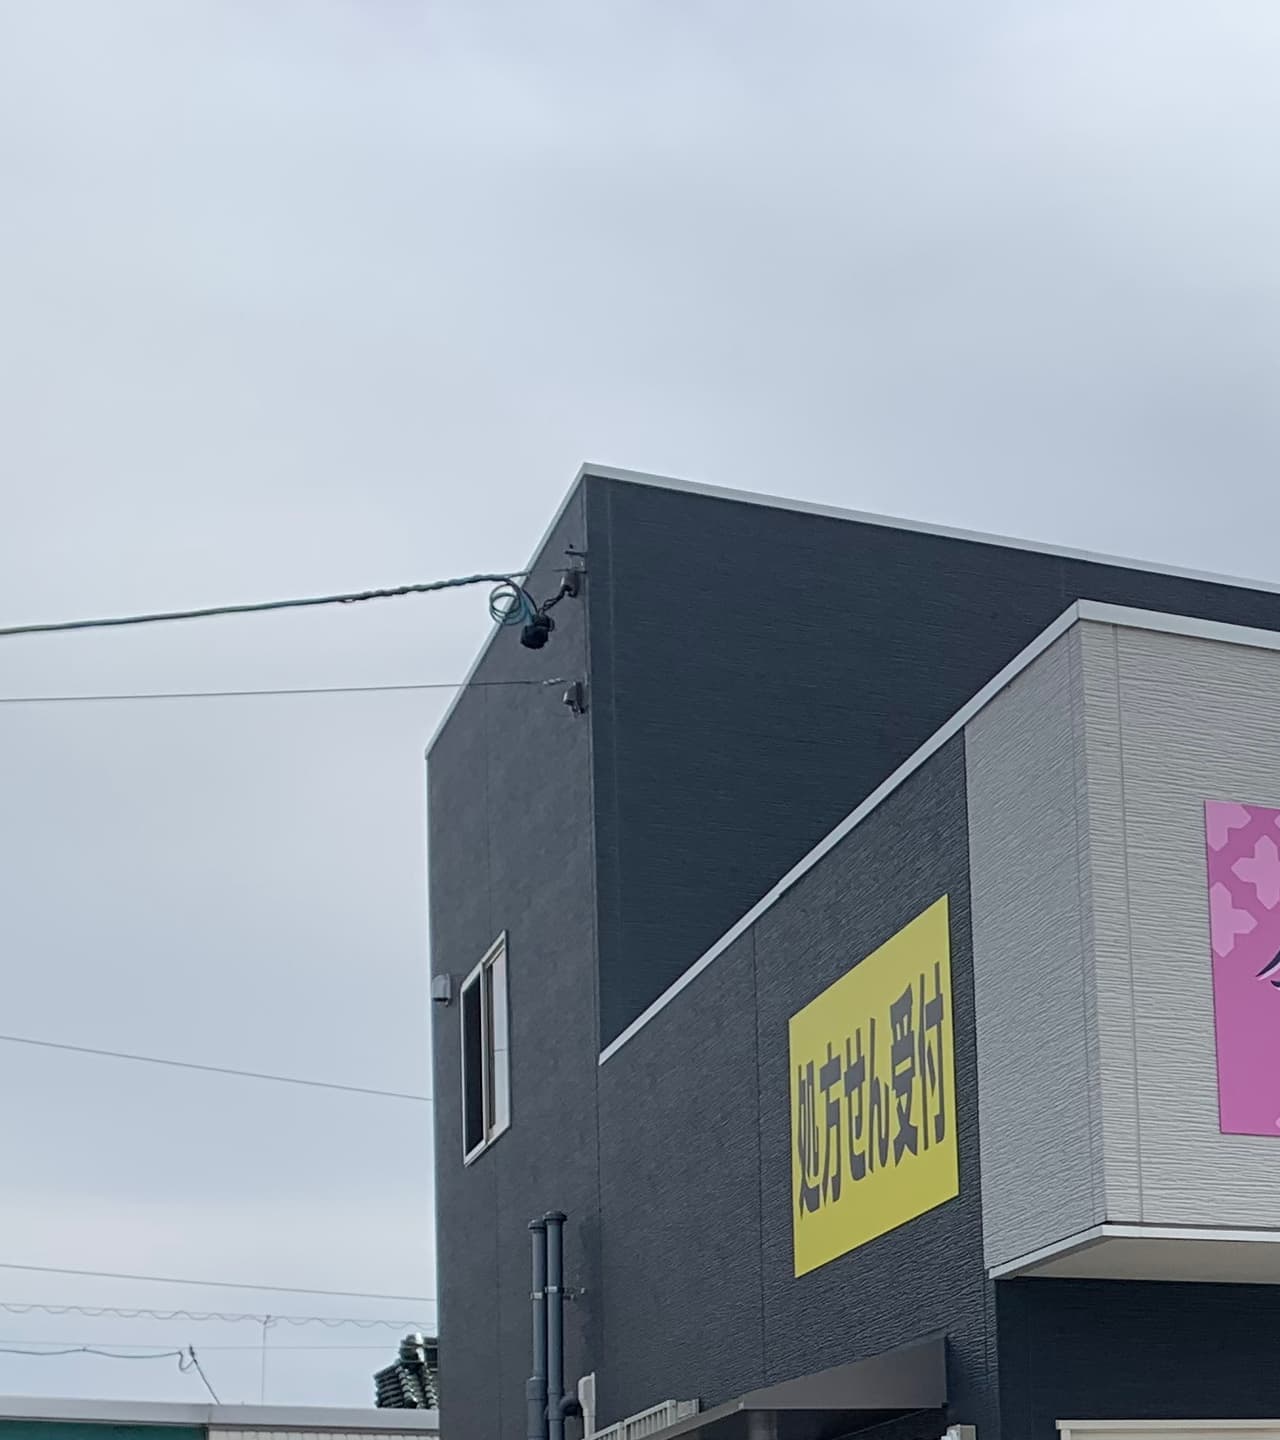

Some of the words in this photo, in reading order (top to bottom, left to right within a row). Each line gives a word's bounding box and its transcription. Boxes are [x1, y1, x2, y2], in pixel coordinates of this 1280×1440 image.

[797, 960, 945, 1219] 処方せん受付
